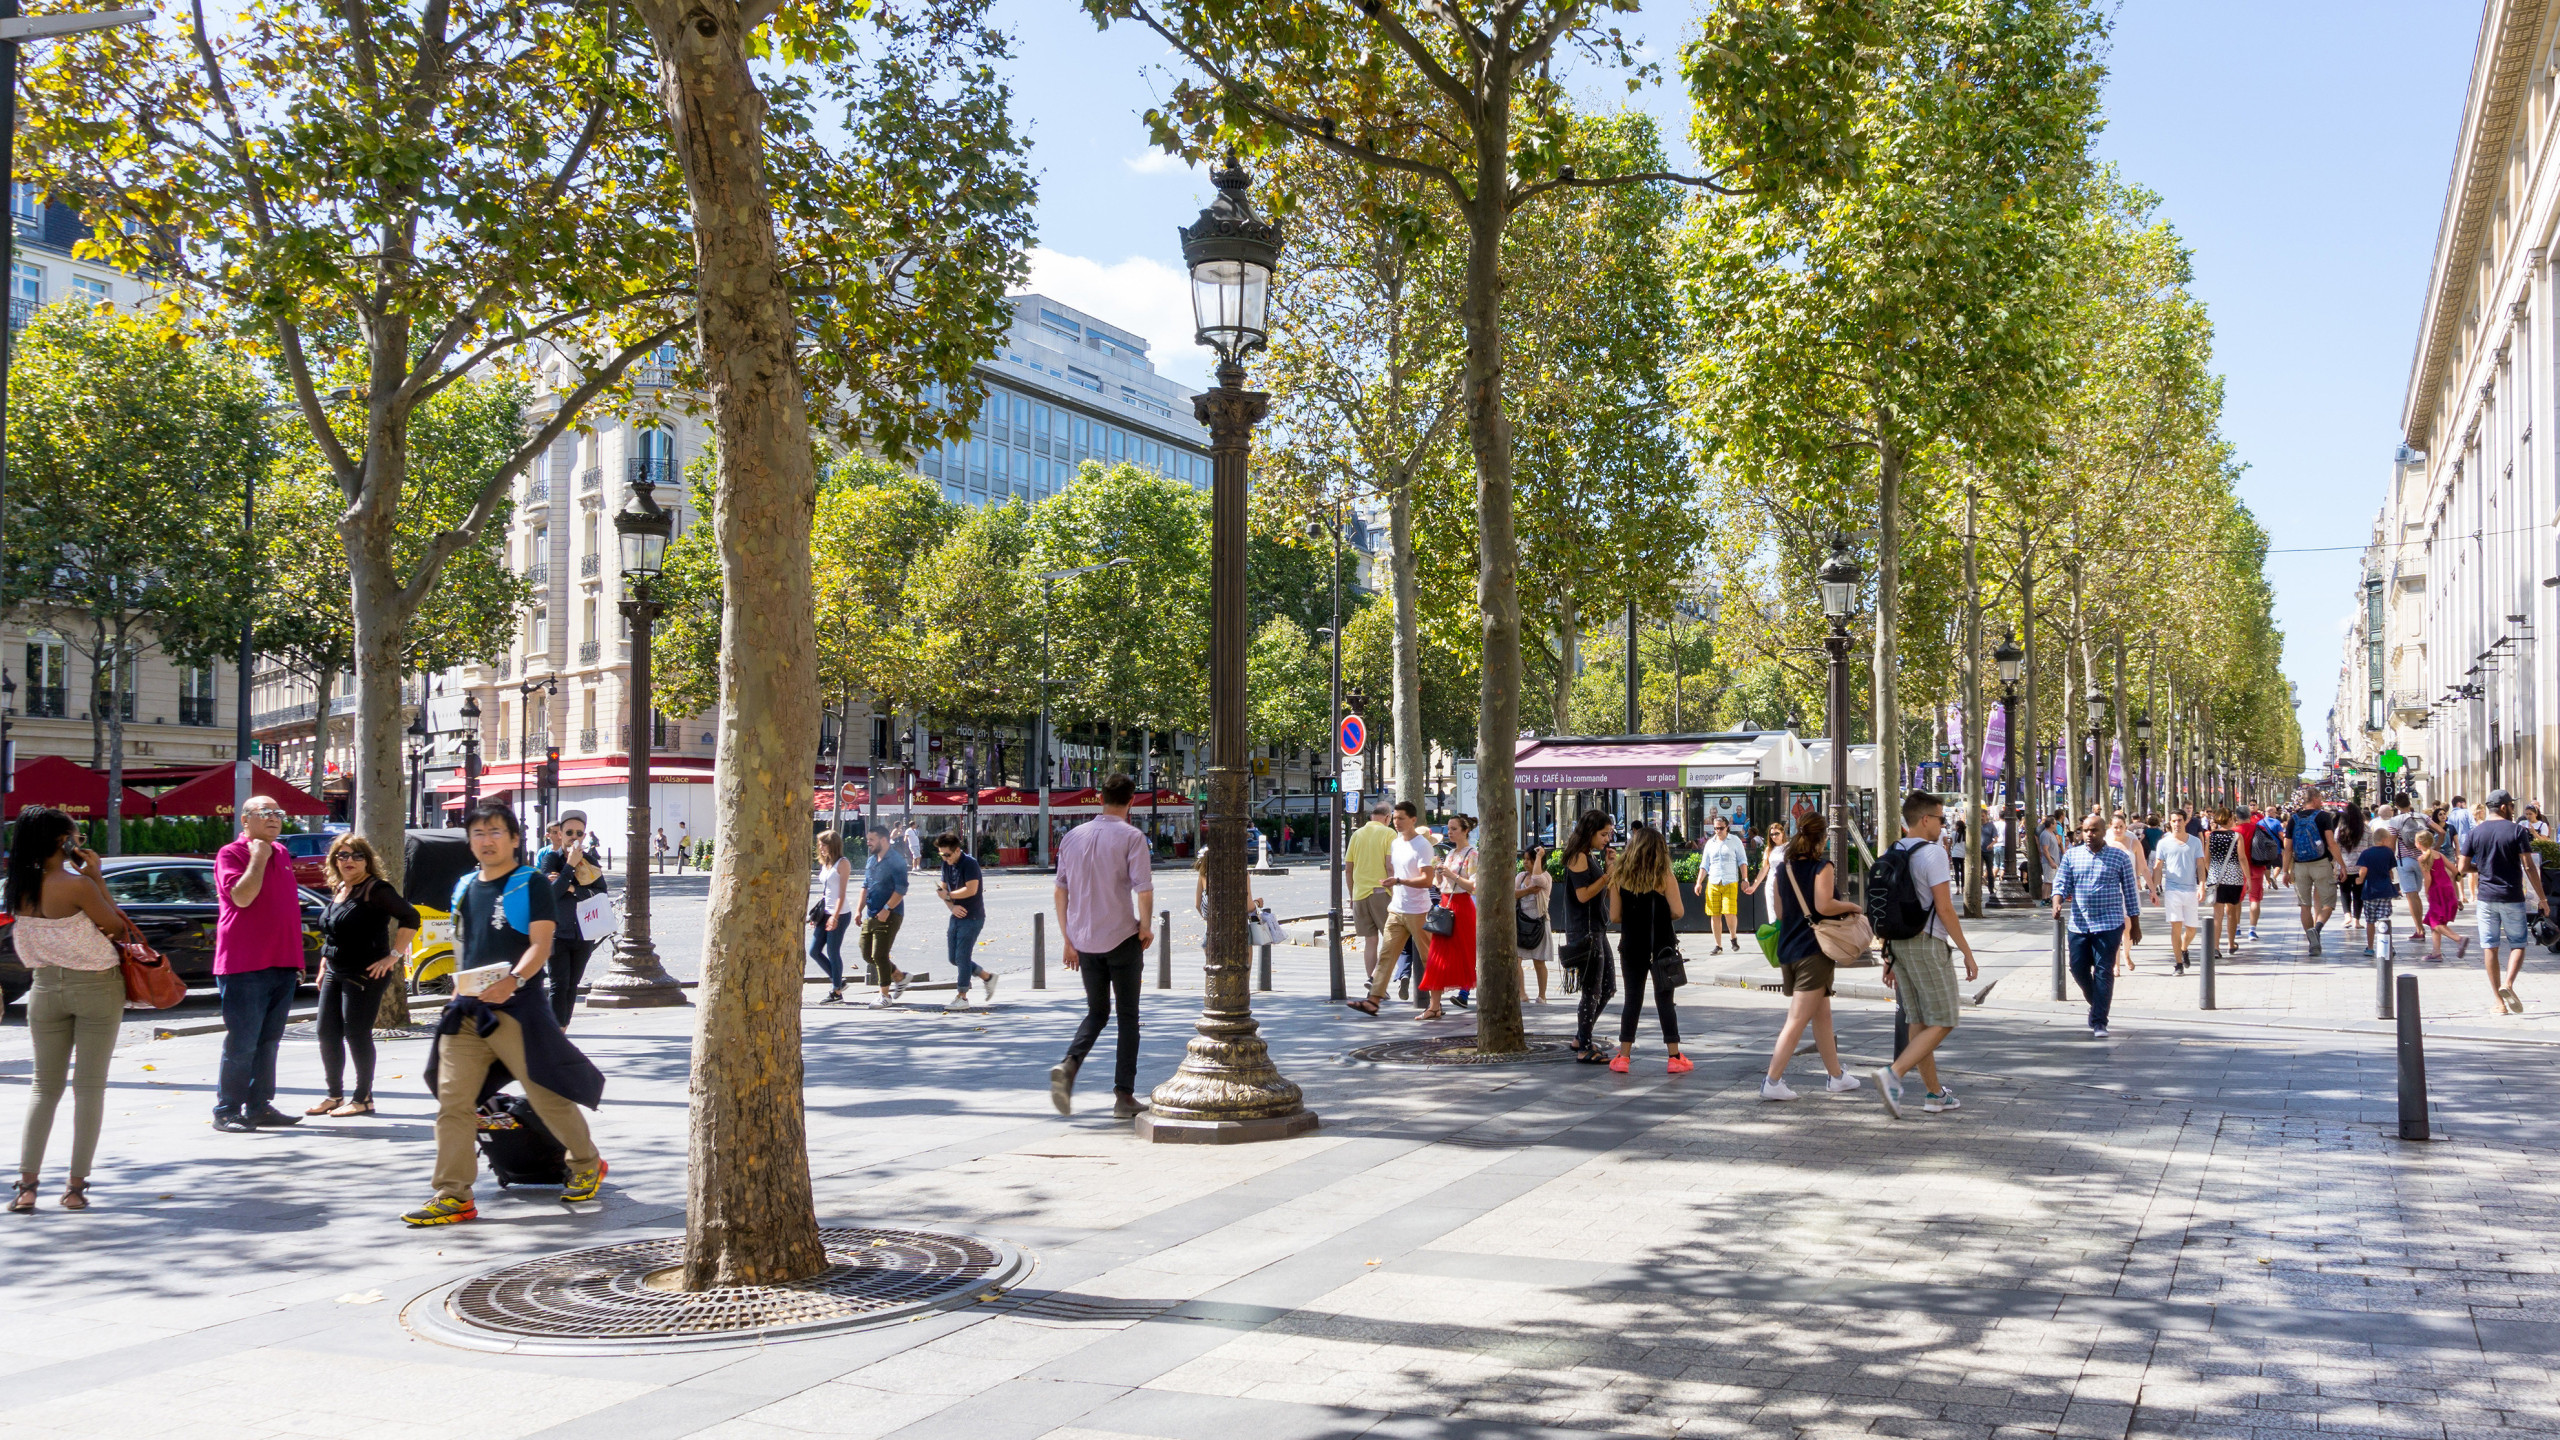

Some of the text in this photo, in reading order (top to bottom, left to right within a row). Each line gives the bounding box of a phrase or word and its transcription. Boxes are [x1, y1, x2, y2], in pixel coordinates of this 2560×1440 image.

[659, 775, 689, 783] L'Alsace
[1542, 772, 1559, 783] CAFÉ
[1565, 774, 1572, 783] la
[1573, 774, 1608, 783] commande
[1658, 773, 1676, 783] place
[897, 795, 928, 803] L'SACE
